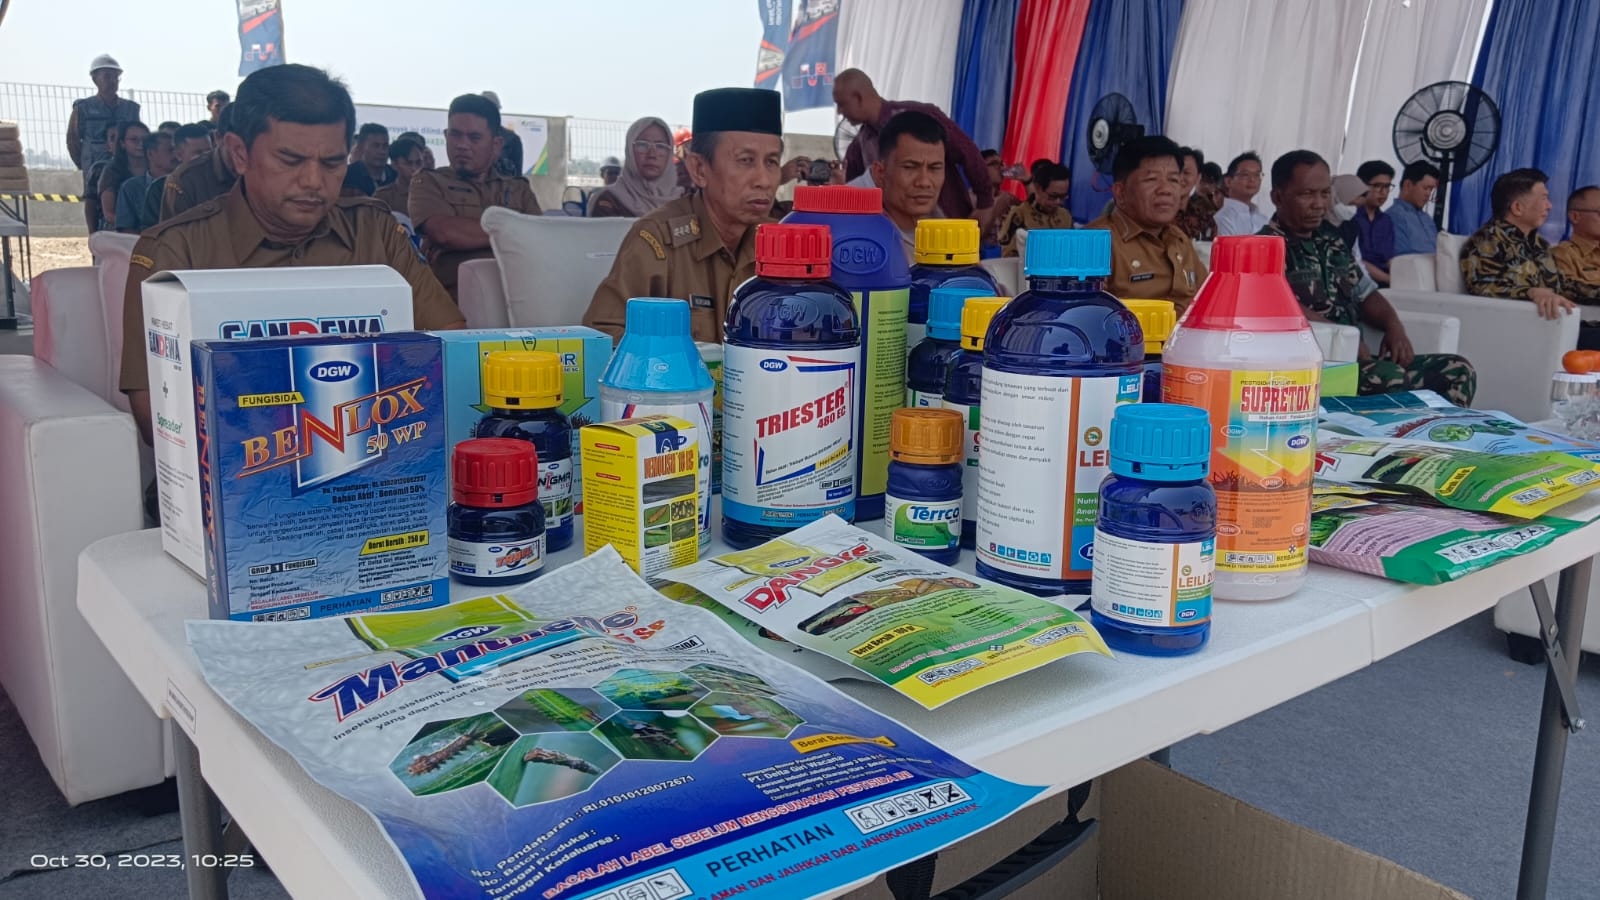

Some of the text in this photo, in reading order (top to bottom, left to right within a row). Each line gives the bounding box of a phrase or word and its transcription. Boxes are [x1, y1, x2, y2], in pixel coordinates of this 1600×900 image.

[317, 365, 351, 377] DGW
[763, 361, 785, 369] DGW
[242, 395, 298, 405] FUNGISIDA
[756, 386, 846, 438] TRIESTER
[1240, 385, 1311, 413] SUPRETOX
[238, 382, 426, 471] BENLOX
[817, 406, 847, 430] 480 EC
[366, 421, 427, 454] 50 WP
[1290, 438, 1308, 447] DGW
[1080, 450, 1110, 467] LEI
[1076, 507, 1098, 516] Anor
[1077, 497, 1098, 505] Nutri
[1178, 574, 1206, 589] LEILI
[320, 597, 372, 612] PERHATIAN
[549, 645, 599, 660] Bahan
[853, 643, 873, 655] Berat
[872, 633, 894, 647] Bersih
[333, 708, 397, 742] Insektisida
[398, 690, 450, 714] sistemik,
[375, 714, 406, 731] yang
[407, 703, 440, 718] dapat
[440, 691, 468, 705] larut
[797, 735, 826, 749] Berat
[748, 754, 845, 784] PT. Delta Giri Wacana
[470, 866, 496, 878] No.
[497, 815, 575, 871] Pendaftaran
[542, 859, 621, 899] BACALAH
[620, 841, 673, 868] LABEL
[670, 820, 739, 851] SEBELUM
[739, 788, 838, 827] MENGGUNAKAN
[837, 774, 893, 799] PESTISIDA
[486, 831, 592, 897] Tanggal Produksi
[705, 823, 835, 879] PERHATIAN
[711, 882, 747, 900] AMAN
[749, 872, 777, 889] DAN
[777, 853, 833, 880] JAUHKAN
[832, 842, 859, 861] DARI
[859, 821, 924, 850] JANGKAUAN
[479, 850, 542, 889] No. Batch
[494, 836, 614, 900] Tanggal Kadaluarsa
